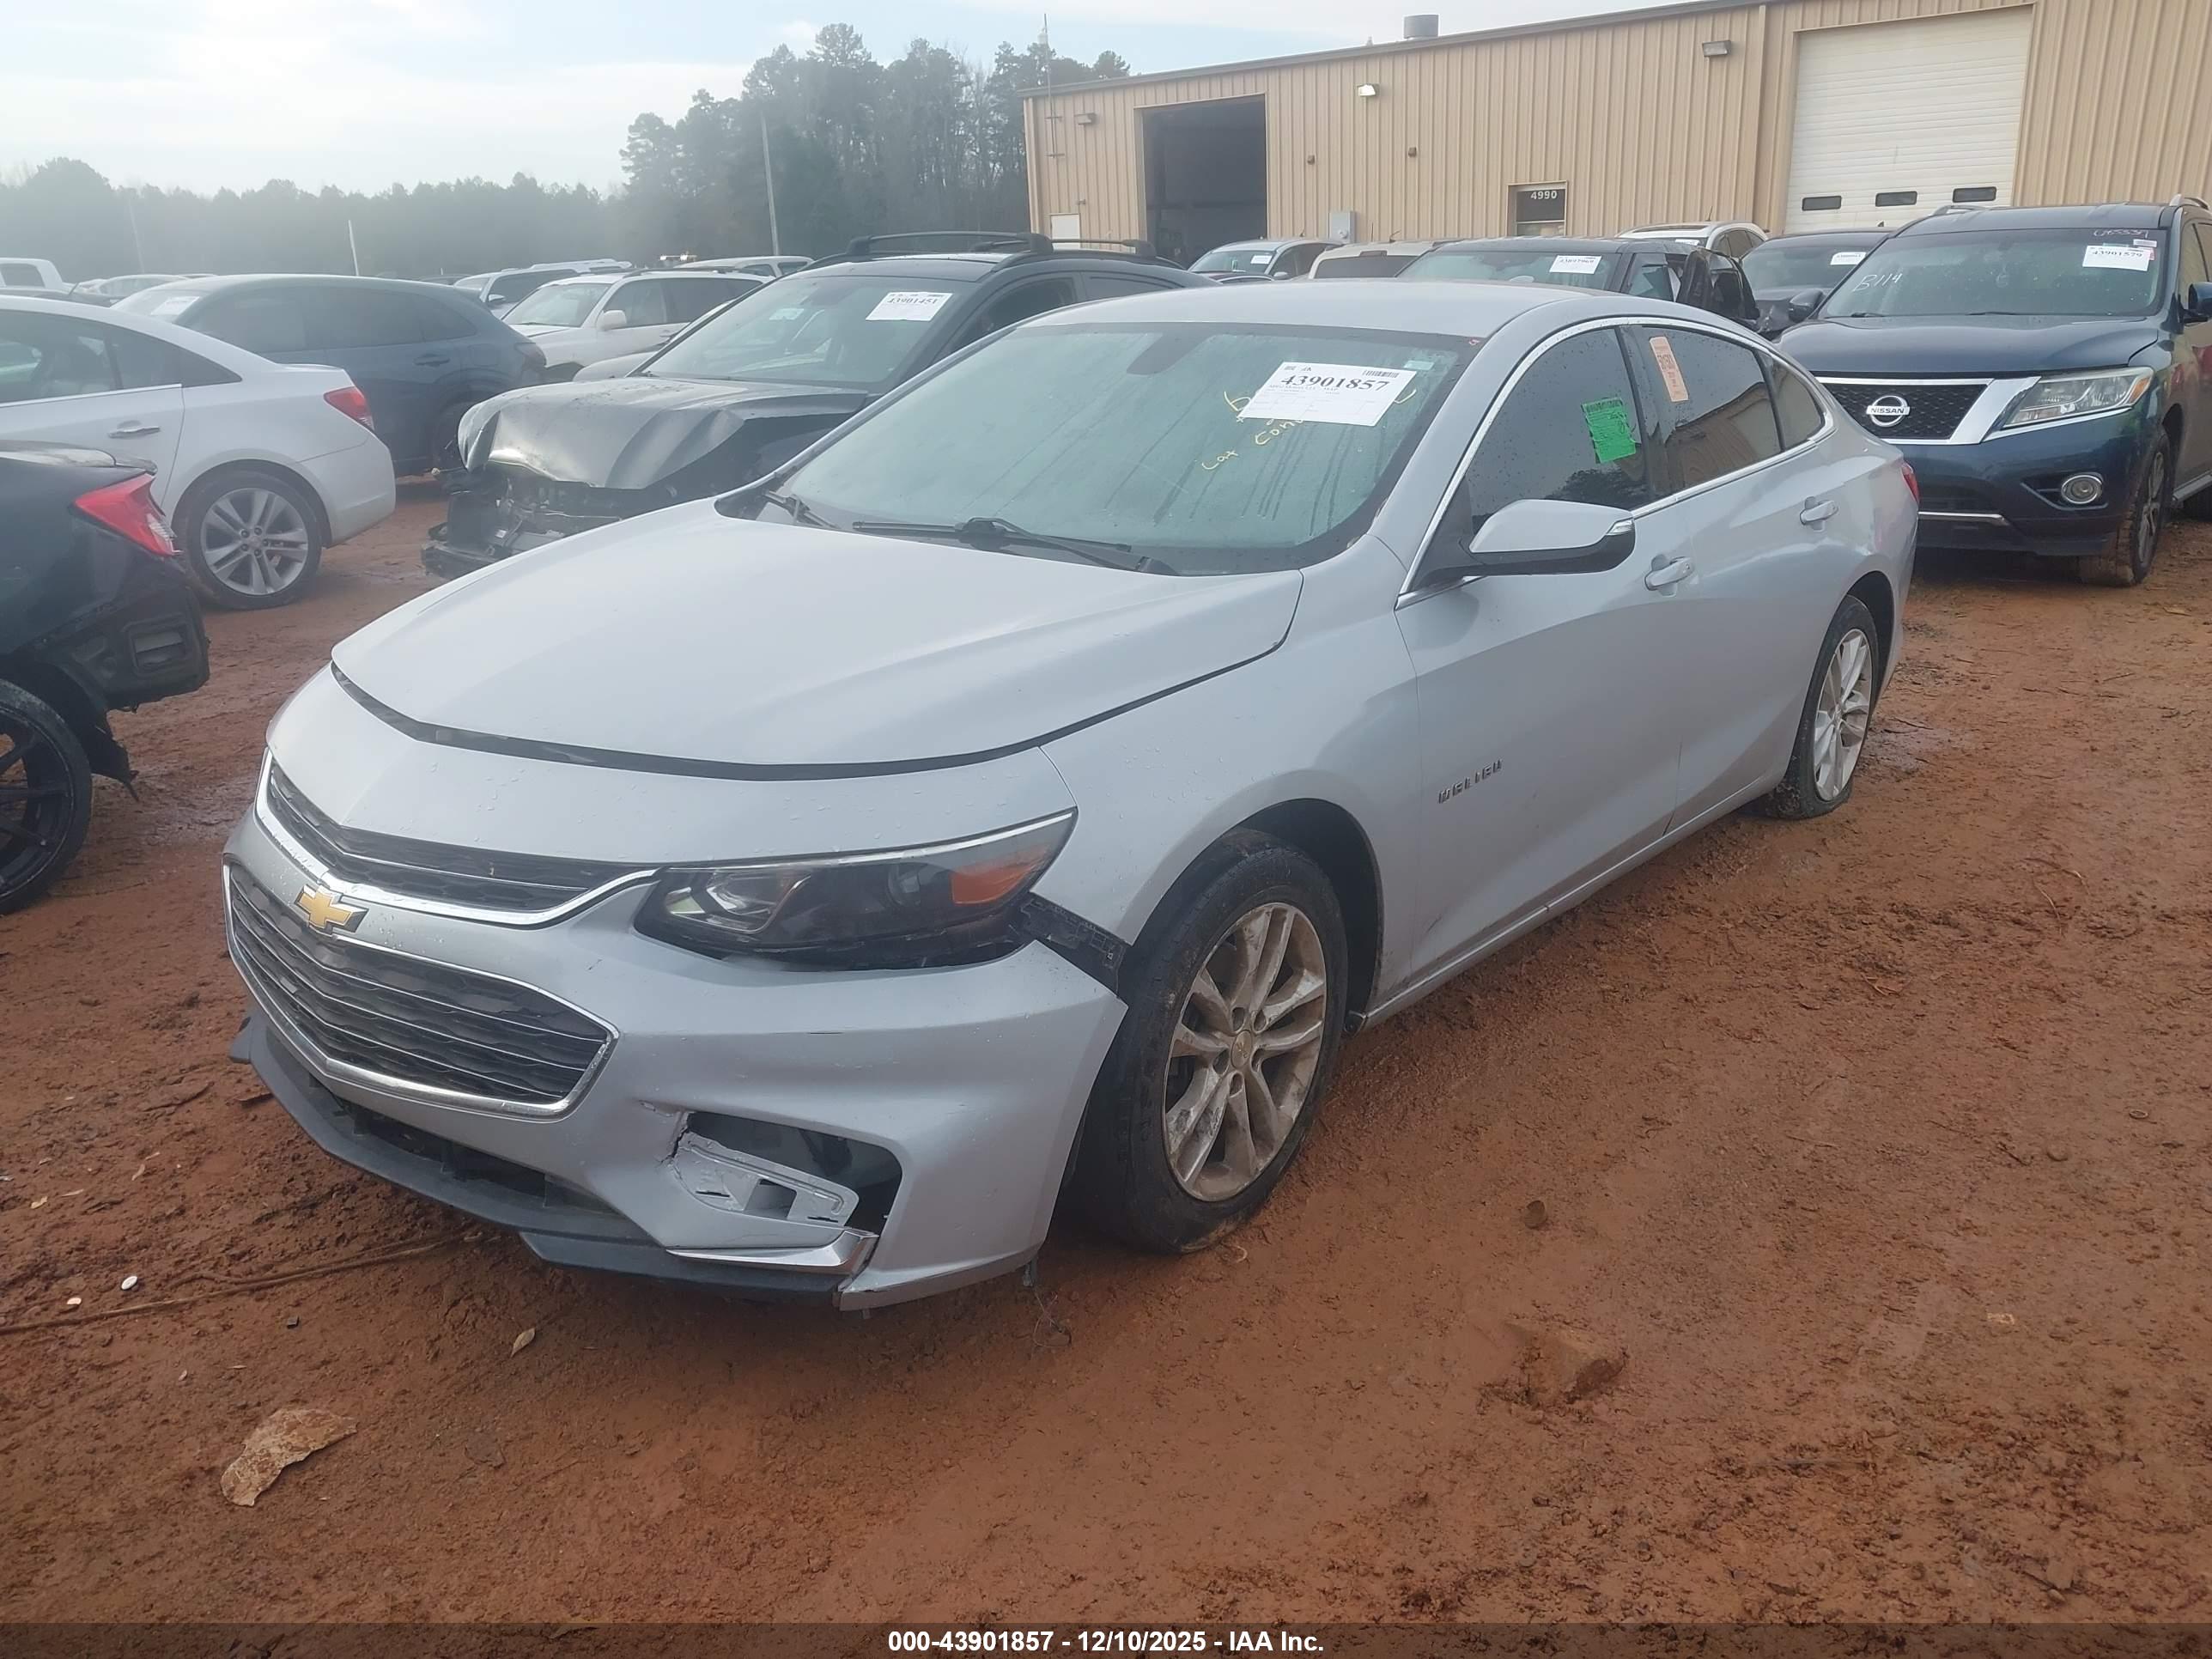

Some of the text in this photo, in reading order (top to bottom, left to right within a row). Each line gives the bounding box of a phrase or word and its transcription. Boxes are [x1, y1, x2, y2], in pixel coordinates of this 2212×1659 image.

[1530, 191, 1558, 200] 4990
[1851, 273, 1903, 292] B114
[1280, 374, 1390, 392] 43901857
